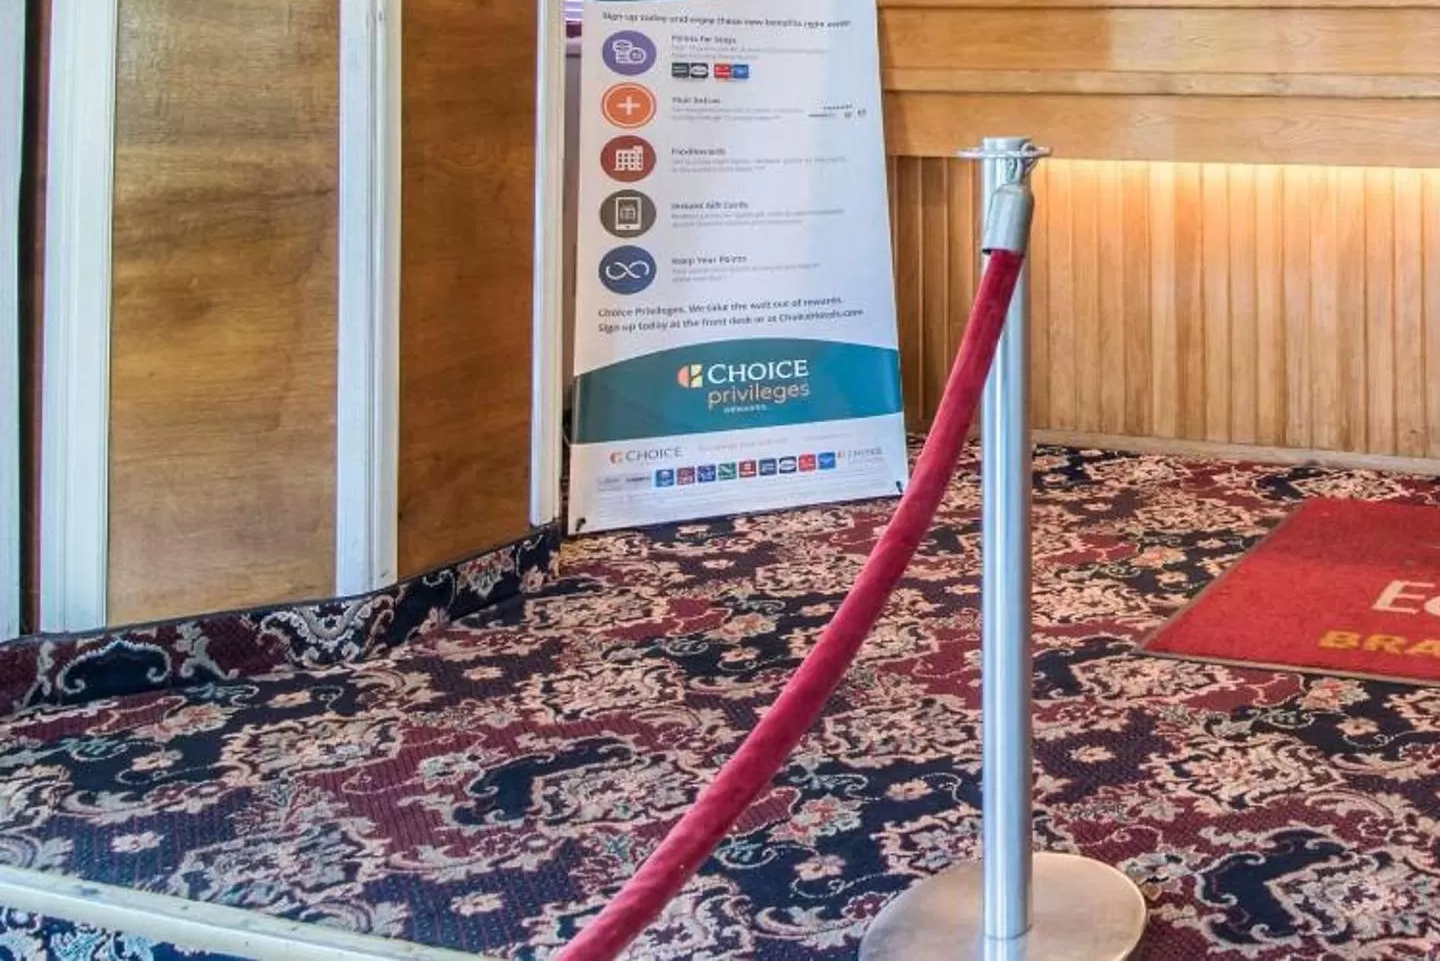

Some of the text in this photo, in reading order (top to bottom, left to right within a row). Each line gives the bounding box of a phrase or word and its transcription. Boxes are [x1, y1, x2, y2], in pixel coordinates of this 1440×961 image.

[598, 308, 632, 317] Choice
[706, 302, 728, 312] take
[731, 301, 748, 310] the
[638, 321, 667, 331] today
[683, 318, 700, 327] the
[702, 317, 727, 327] front
[707, 359, 809, 384] CHOICE
[707, 383, 810, 411] privileges
[625, 446, 684, 462] CHOICE
